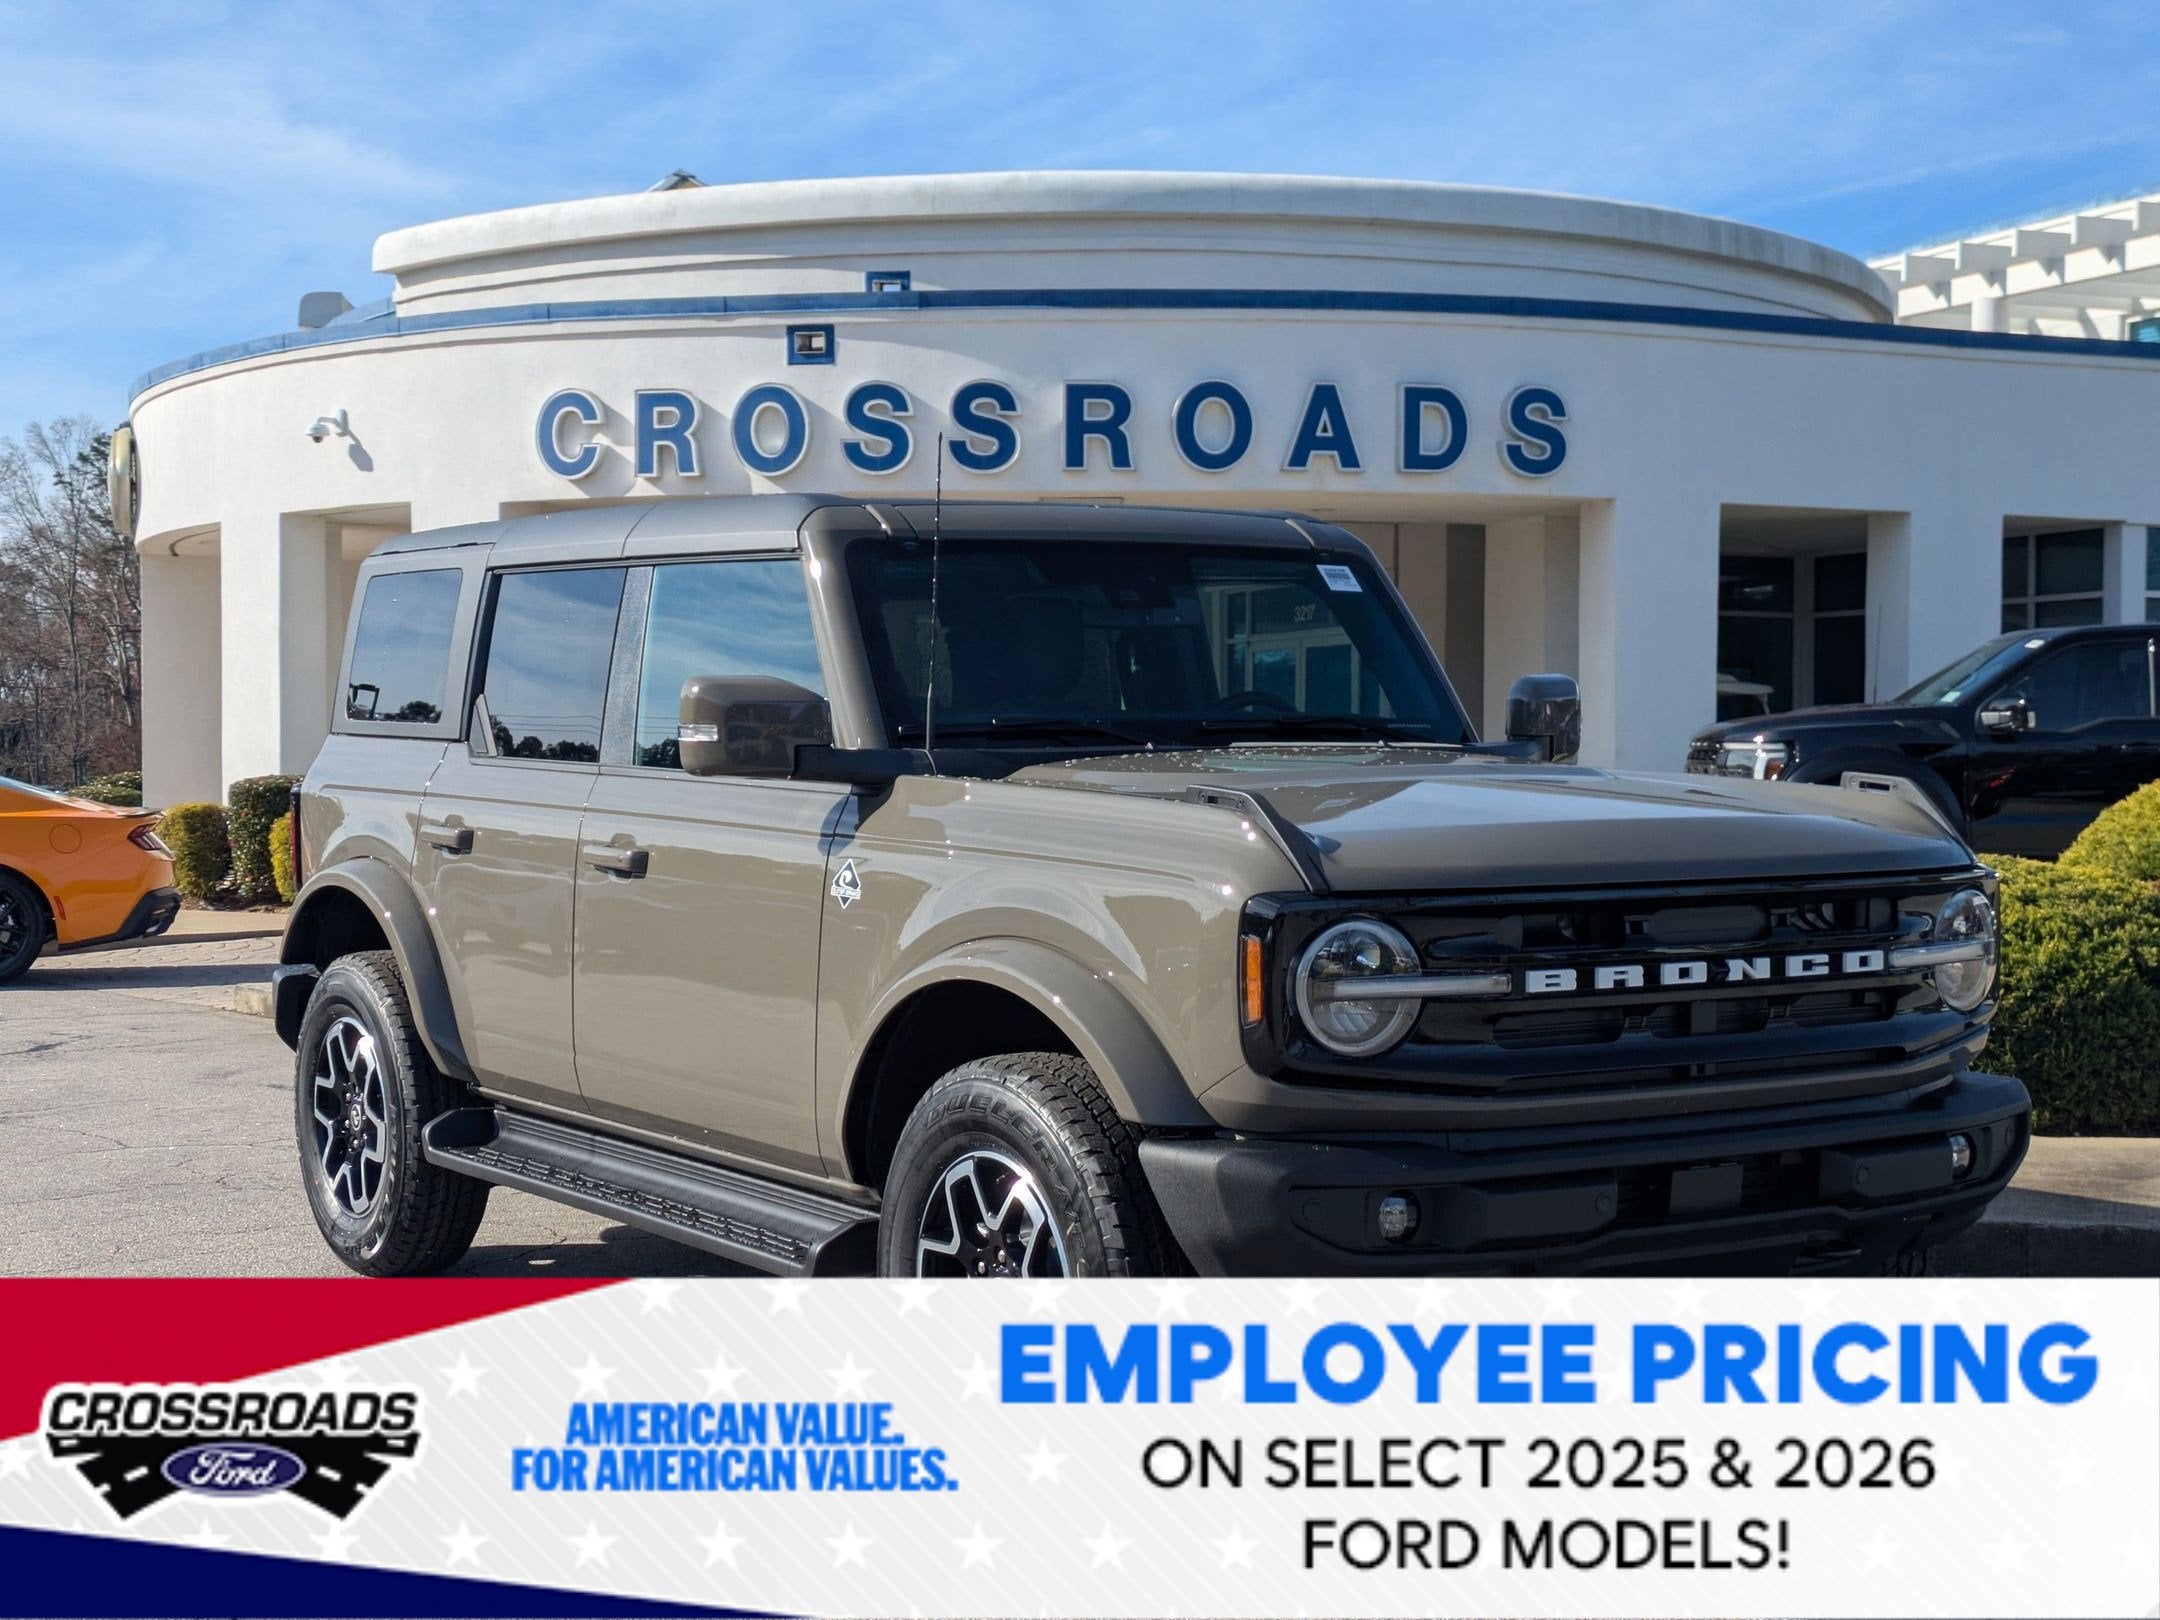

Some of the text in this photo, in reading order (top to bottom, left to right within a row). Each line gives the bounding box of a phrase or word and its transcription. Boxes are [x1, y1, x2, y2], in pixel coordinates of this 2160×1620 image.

[535, 378, 1570, 480] CROSSROADS
[1525, 949, 1885, 993] BRONCO
[926, 1092, 1059, 1171] DUELER
